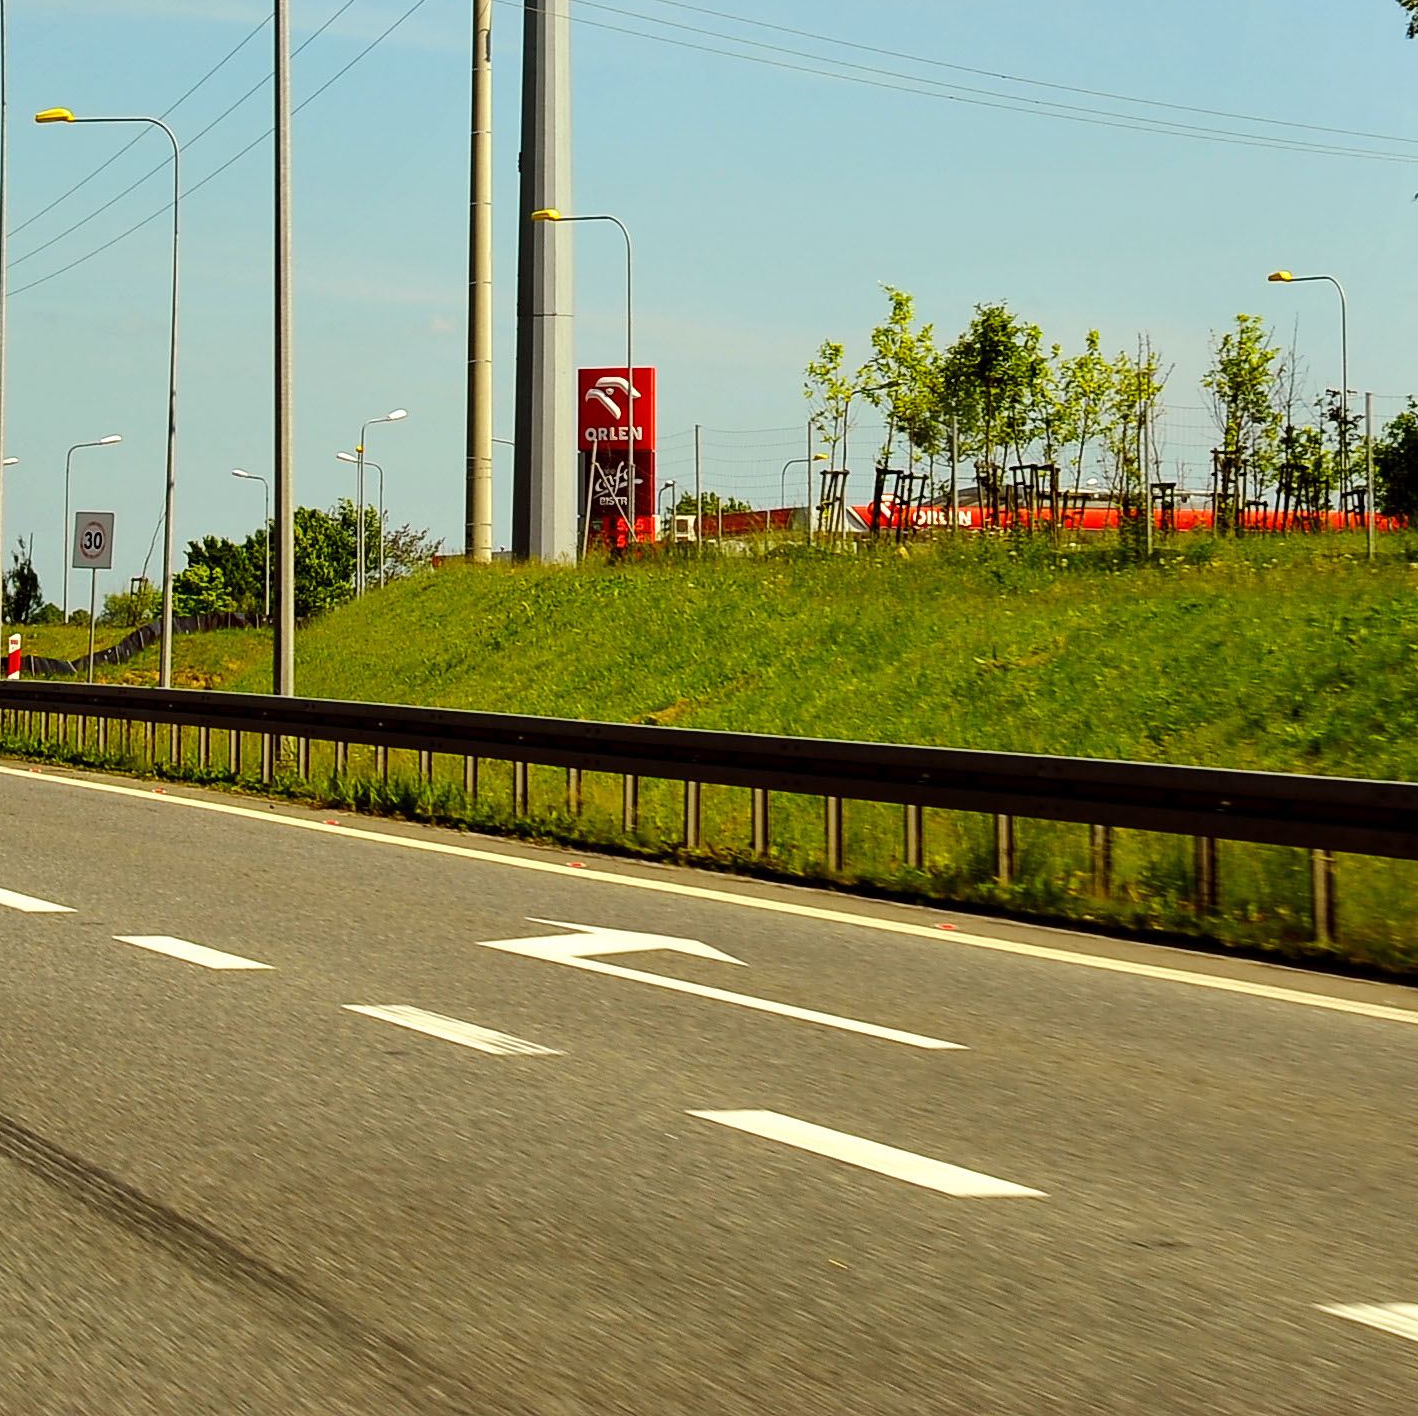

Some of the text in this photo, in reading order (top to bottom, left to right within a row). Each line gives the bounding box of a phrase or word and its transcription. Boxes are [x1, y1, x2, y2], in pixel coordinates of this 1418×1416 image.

[585, 427, 643, 441] ORLEN
[599, 496, 628, 505] BISTR
[84, 531, 103, 549] 30
